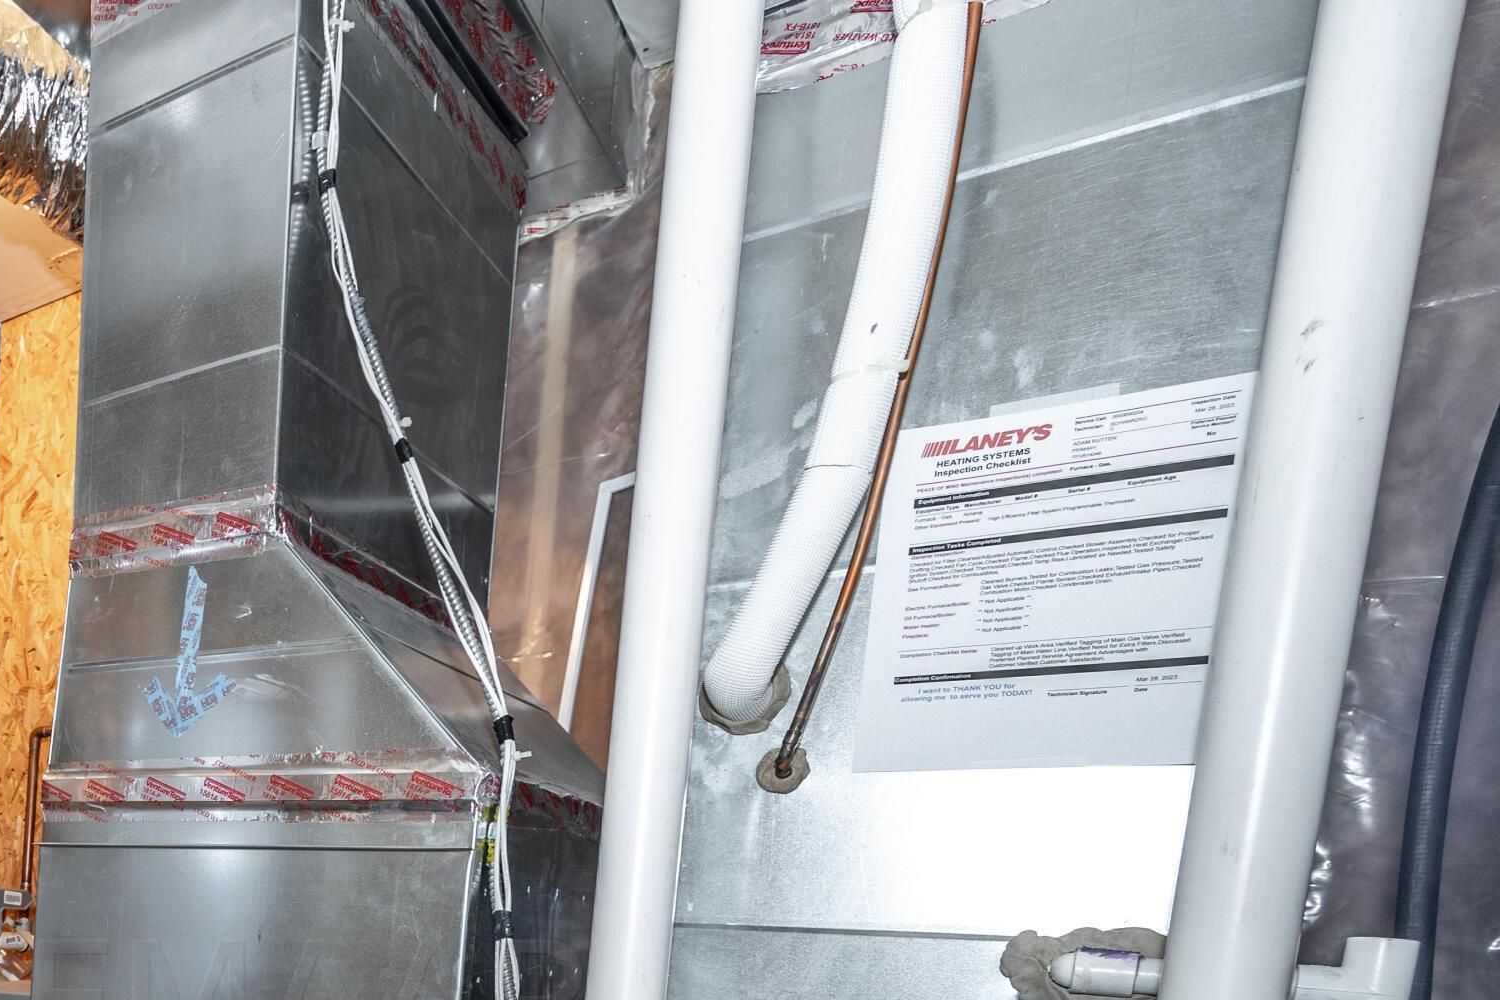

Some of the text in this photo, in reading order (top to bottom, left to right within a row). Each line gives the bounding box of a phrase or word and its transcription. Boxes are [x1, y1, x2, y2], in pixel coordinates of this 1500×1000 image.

[949, 424, 1052, 454] LANEY'S
[935, 457, 1031, 477] Inspection Checklist
[937, 448, 1030, 468] HEATING SYSTEMS
[916, 507, 944, 515] Equipment
[1128, 477, 1162, 485] Equipment
[918, 496, 951, 505] Equipment
[913, 545, 945, 553] Inspection
[967, 538, 1001, 546] Completed
[900, 695, 932, 703] allowing
